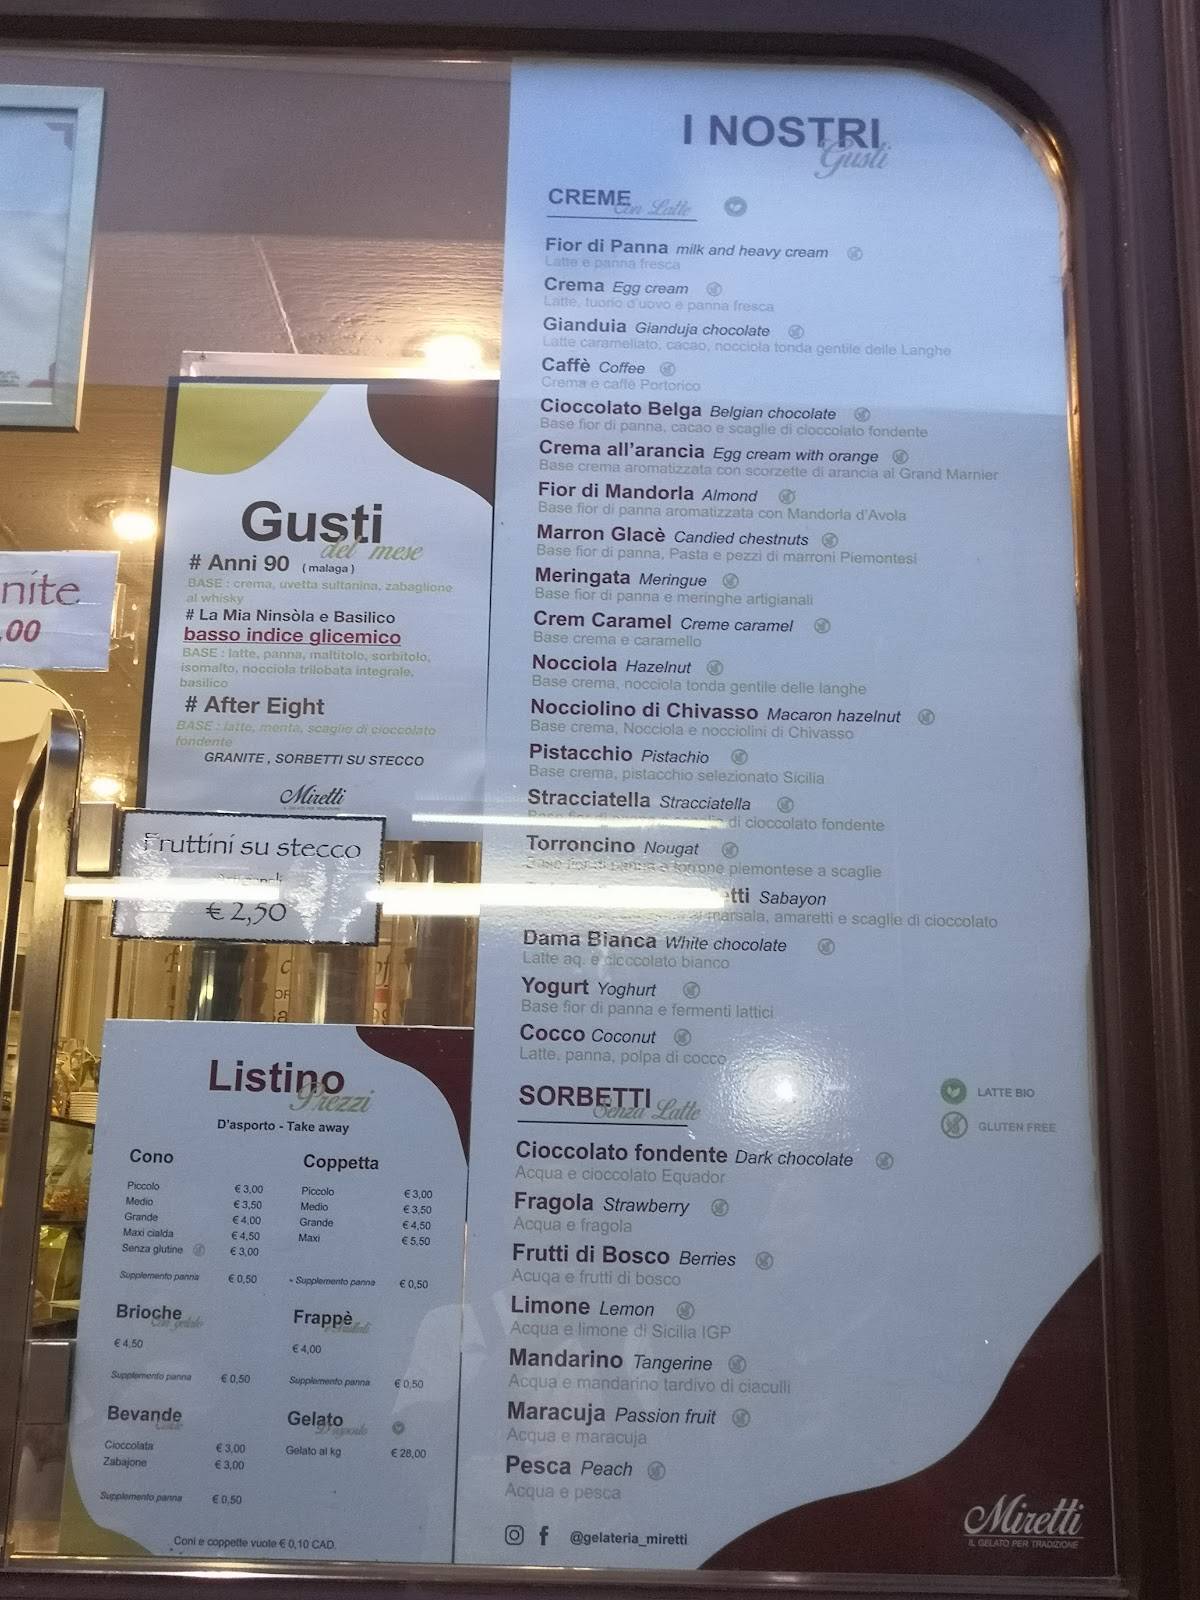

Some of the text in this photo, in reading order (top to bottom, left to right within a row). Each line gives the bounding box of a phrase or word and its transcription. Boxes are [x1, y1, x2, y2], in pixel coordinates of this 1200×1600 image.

[682, 114, 881, 150] I NOSTRI
[814, 139, 891, 179] Gusti
[548, 188, 631, 207] CREME
[546, 238, 828, 260] Fior di Panna milk and heavy cream
[544, 277, 688, 296] Crema Egg cream
[544, 317, 770, 337] Gianduia Gianduja chocolate
[542, 357, 645, 374] Caffè Coffee
[541, 398, 836, 420] Cioccolato Belga Belgian chocolate
[540, 440, 600, 455] Crema
[713, 448, 741, 462] Egg
[746, 451, 790, 460] cream
[796, 450, 824, 460] with
[829, 453, 878, 464] orange
[899, 468, 999, 480] Grand Marnier
[539, 482, 758, 502] Fior di Mandorla Almond
[242, 500, 382, 544] Gusti
[538, 524, 808, 545] Marron Glacè Candied chestnuts
[190, 554, 289, 571] # Anni 90
[368, 544, 423, 561] mese
[536, 567, 706, 589] Meringata Meringue
[186, 609, 395, 623] # La Mia Ninsòla e Basilico
[534, 610, 793, 632] Crem Caramel Creme caramel
[184, 627, 401, 646] basso indice glicemico
[533, 654, 691, 674] Nocciola Hazelnut
[185, 696, 324, 718] # After Eight
[532, 699, 901, 722] Nocciolino di Chivasso Macaron hazelnut
[205, 752, 424, 766] GRANITE SORBETTI SU STECCO
[530, 744, 709, 763] Pistacchio Pistachio
[280, 784, 346, 805] Miretti
[528, 789, 750, 810] Stracciatella Stracciatella
[729, 815, 740, 828] di
[745, 816, 817, 830] cioccolato
[822, 818, 885, 832] fondente
[143, 832, 361, 860] Fruttini su stecco
[526, 835, 698, 858] Torroncino Nougat
[760, 891, 826, 908] Sabayon
[206, 902, 286, 924] € 2,50
[524, 930, 786, 952] Dama Bianca White chocolate
[522, 977, 656, 999] Yogurt Yoghurt
[672, 1004, 773, 1019] fermenti lattici
[520, 1024, 656, 1044] Cocco Coconut
[209, 1060, 345, 1095] Listino
[289, 1081, 375, 1113] Prezzi
[519, 1085, 651, 1108] SORBETTI
[978, 1088, 1035, 1098] LATTE BIO
[652, 1097, 702, 1121] Latte
[218, 1119, 349, 1135] D'asporto Take away
[978, 1122, 1056, 1132] GLUTEN FREE
[130, 1149, 173, 1163] Cono
[304, 1154, 378, 1172] Coppetta
[516, 1141, 853, 1166] Cioccolato fondente Dark chocolate
[302, 1186, 334, 1196] Piccolo
[515, 1192, 690, 1216] Fragola Strawberry
[300, 1218, 334, 1227] Grande
[514, 1216, 632, 1236] Acqua fragola
[513, 1243, 736, 1266] Frutti di Bosco Berries
[116, 1303, 182, 1320] Brioche
[512, 1296, 654, 1316] Limone Lemon
[293, 1309, 353, 1328] Frappè
[510, 1348, 712, 1373] Mandarino Tangerine
[107, 1405, 182, 1423] Bevande
[287, 1411, 343, 1428] Gelato
[508, 1401, 716, 1426] Maracuja Passion fruit
[104, 1440, 154, 1450] Cioccolata
[103, 1457, 147, 1468] Zabajone
[506, 1455, 632, 1476] Pesca Peach
[964, 1494, 1085, 1535] Miretti
[570, 1531, 687, 1545] @gelateria_miretti
